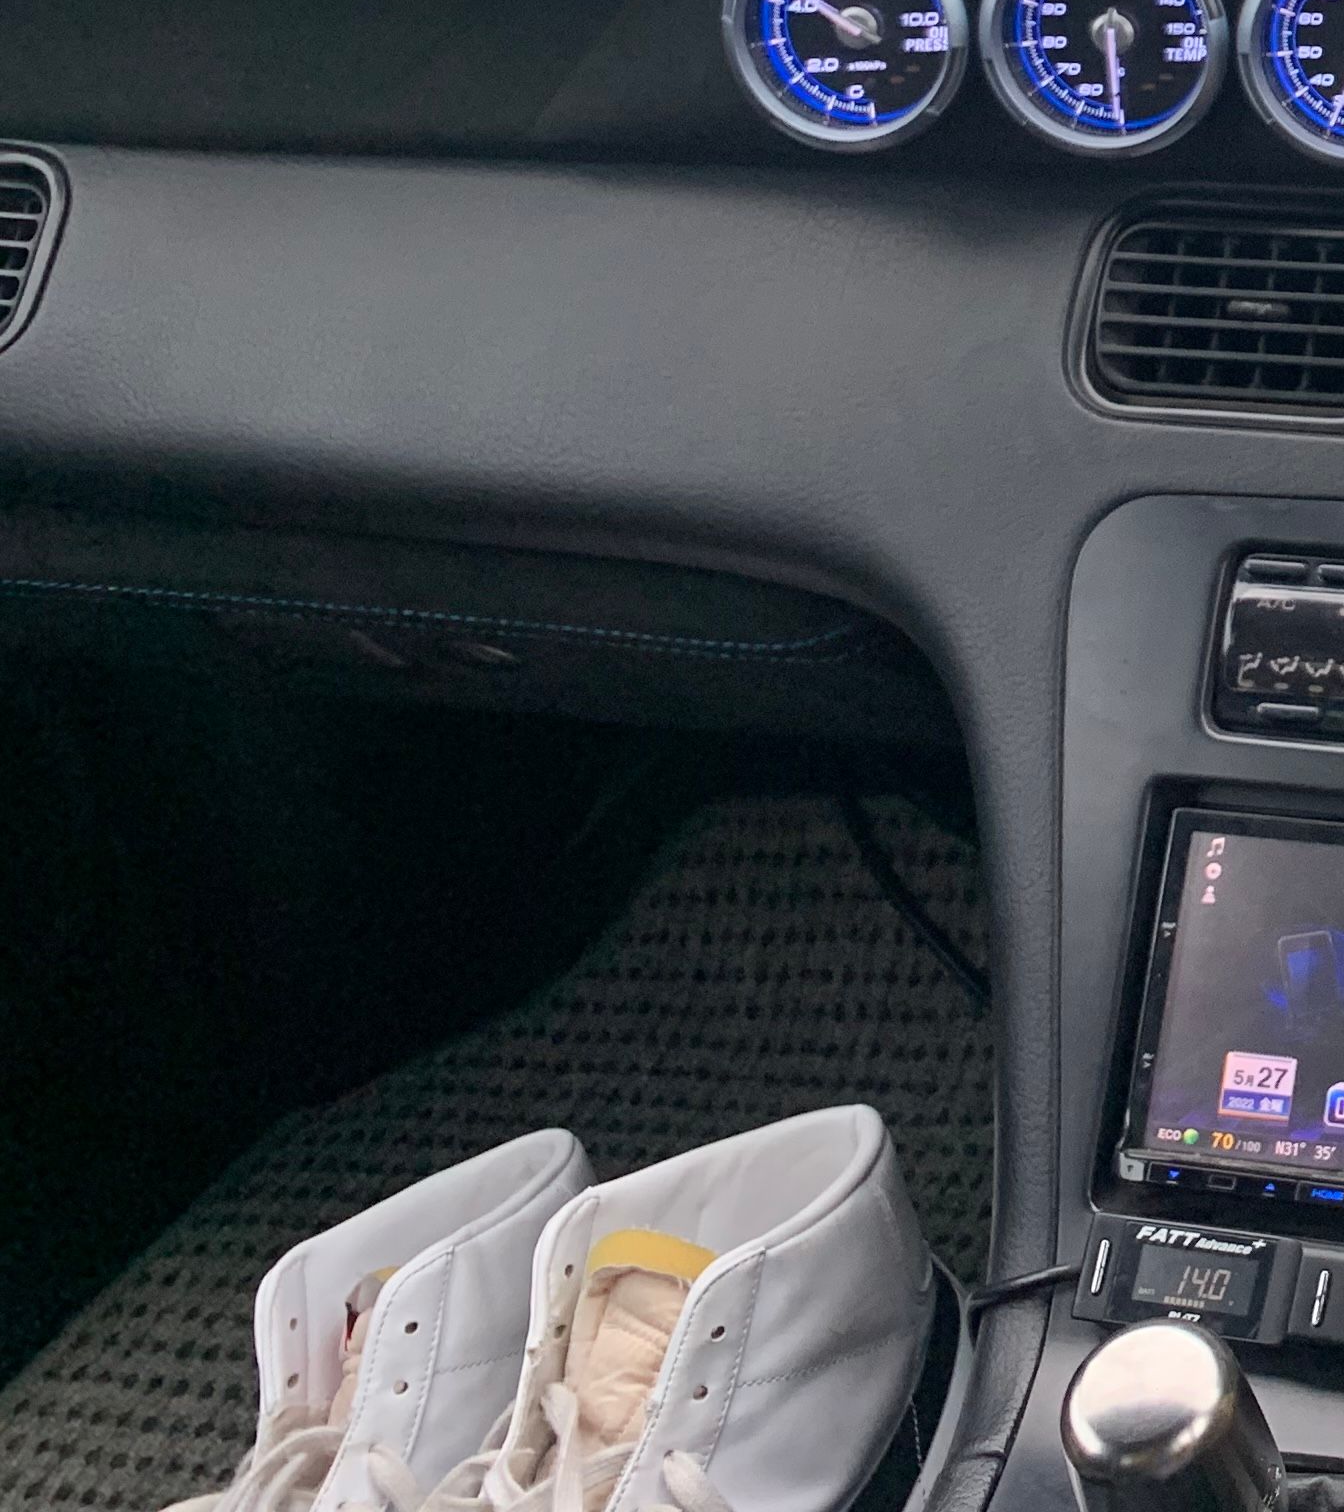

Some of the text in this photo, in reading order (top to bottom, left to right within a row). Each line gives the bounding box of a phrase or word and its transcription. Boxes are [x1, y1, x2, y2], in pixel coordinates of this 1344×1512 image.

[900, 12, 939, 26] 10.0
[1166, 23, 1196, 35] 150
[1182, 38, 1206, 49] OIL
[1164, 49, 1207, 62] TEMP
[806, 58, 839, 72] 2.0
[1056, 63, 1081, 76] 70
[1309, 74, 1334, 86] 40
[1257, 599, 1295, 612] A/C
[1257, 1066, 1289, 1089] 27
[1157, 1128, 1183, 1141] ECO
[1211, 1131, 1235, 1151] 70
[1136, 1226, 1200, 1248] FATT
[1177, 1266, 1232, 1301] 14.0
